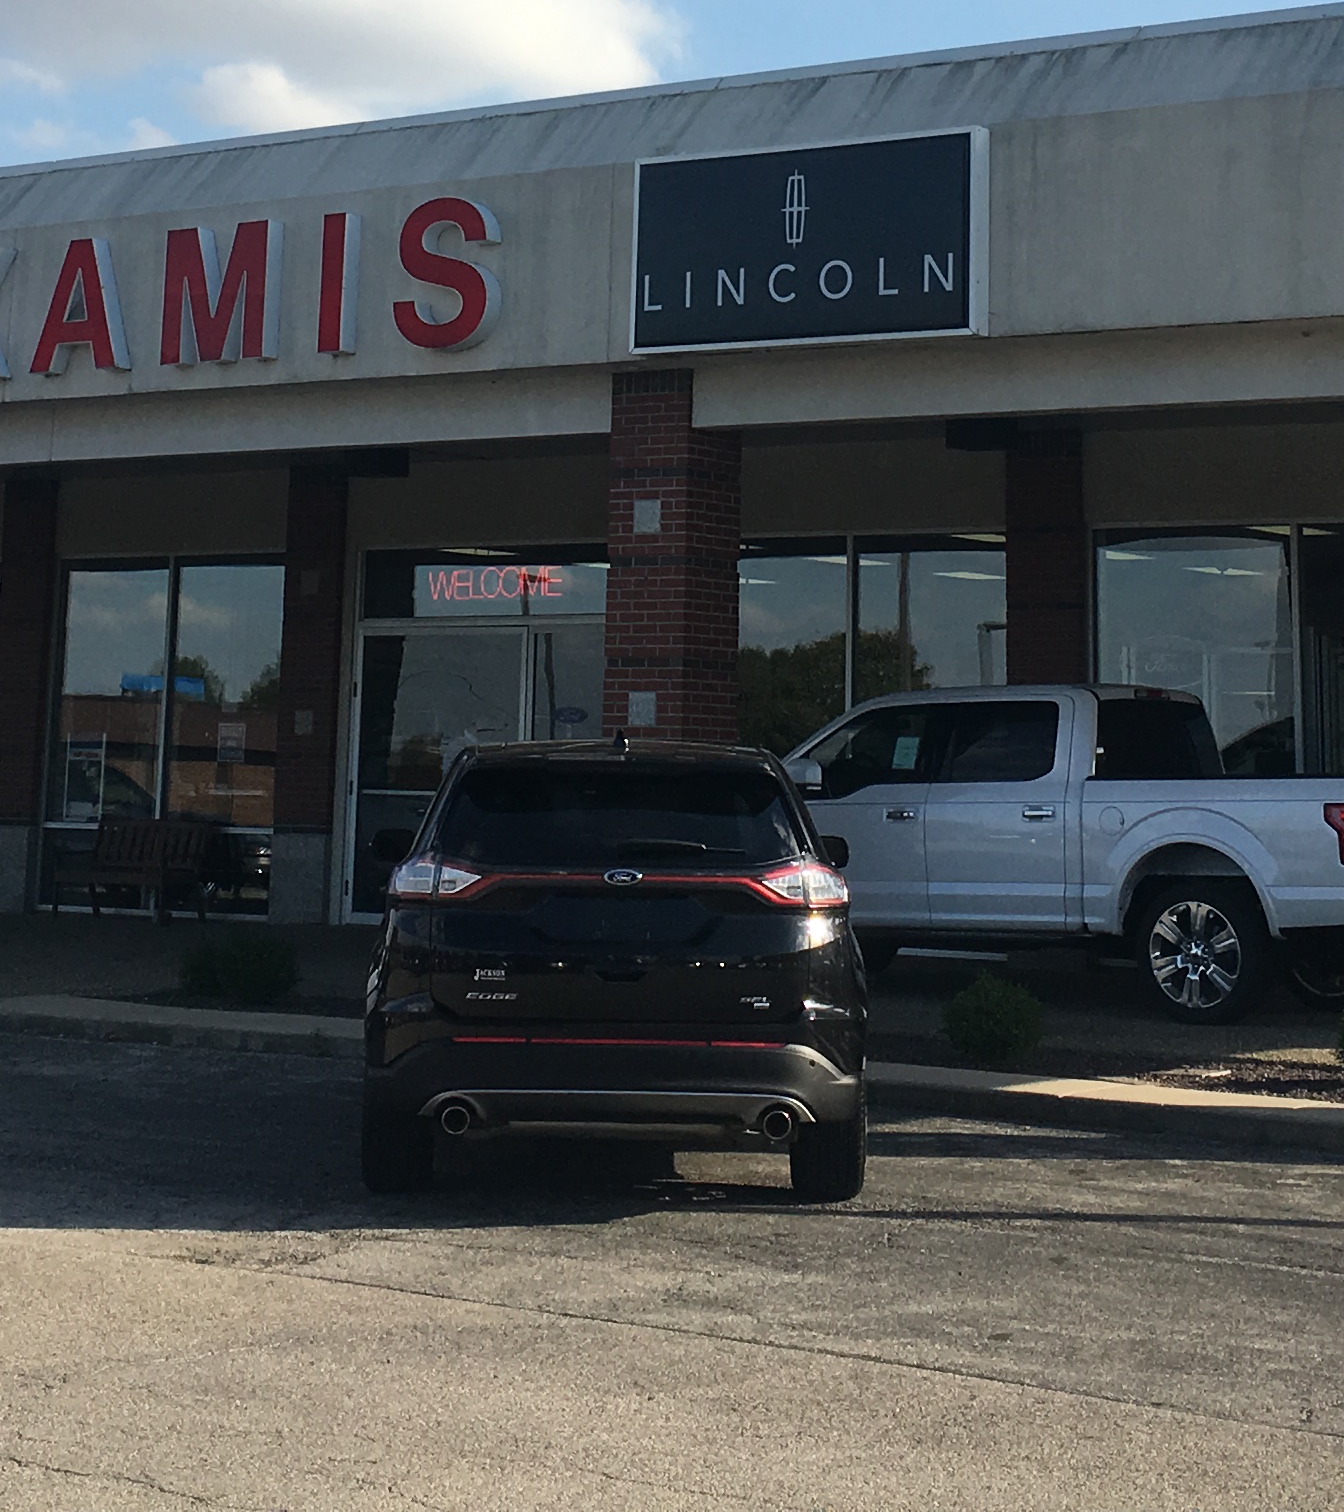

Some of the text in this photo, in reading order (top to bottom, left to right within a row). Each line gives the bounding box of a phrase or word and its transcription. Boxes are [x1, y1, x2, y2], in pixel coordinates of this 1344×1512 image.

[643, 252, 954, 313] LINCOLN
[428, 565, 563, 601] WELCOME
[465, 992, 518, 1000] EDGE
